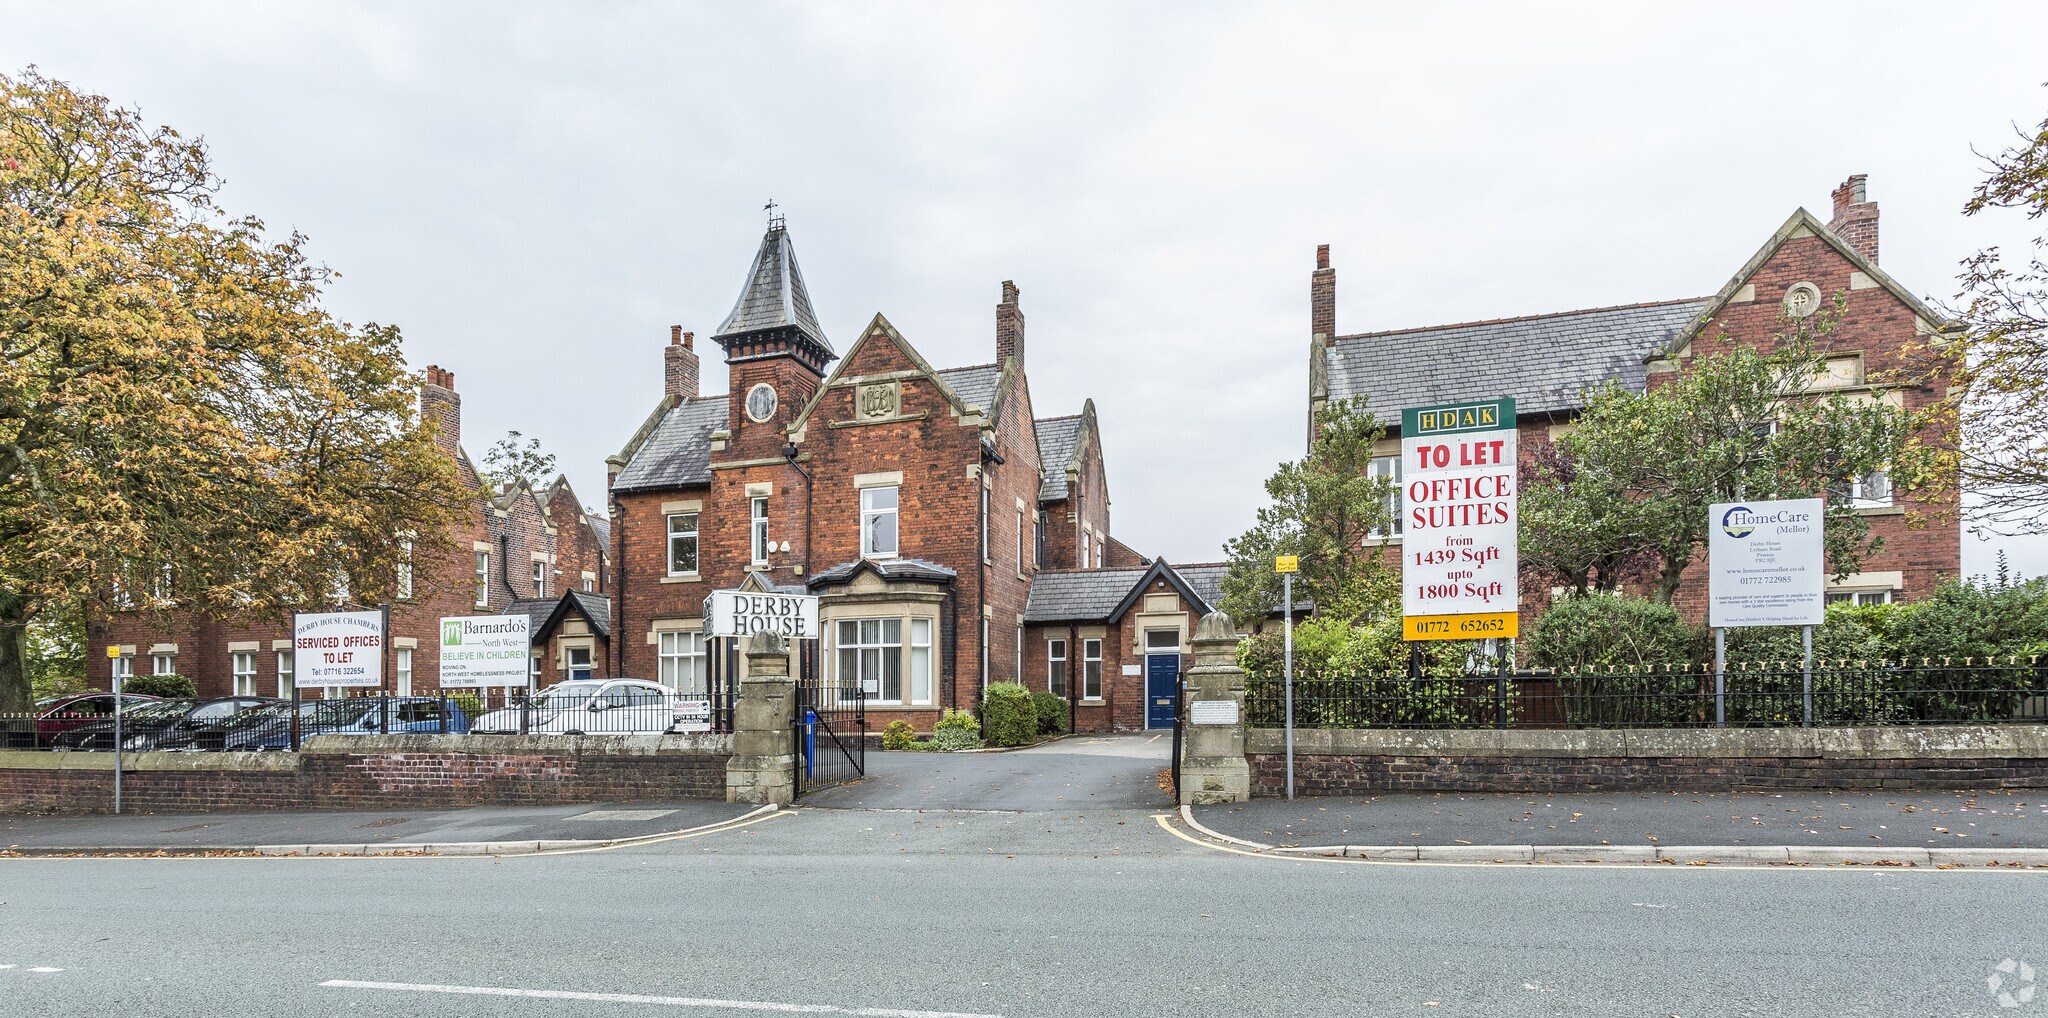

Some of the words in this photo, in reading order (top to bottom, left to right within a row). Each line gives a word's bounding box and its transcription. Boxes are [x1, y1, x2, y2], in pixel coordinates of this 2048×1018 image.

[1422, 408, 1494, 429] HDAK
[1417, 444, 1450, 469] TO
[1460, 440, 1504, 466] LET
[1409, 474, 1511, 503] OFFICE
[1413, 501, 1509, 529] SUITES
[1734, 510, 1809, 525] HomeCare
[1776, 525, 1810, 535] (Mellor)
[1446, 536, 1473, 547] from
[1415, 549, 1455, 566] 1439
[1461, 546, 1500, 569] Sqft
[1447, 570, 1473, 582] upto
[1726, 566, 1806, 574] www.homecaremellor.co.uk
[1740, 577, 1762, 585] 01772
[1765, 576, 1792, 584] 722985
[1418, 583, 1458, 599] 1800
[1464, 581, 1503, 603] Sqft
[733, 595, 805, 617] DERBY
[297, 621, 319, 635] DERBY
[320, 617, 342, 627] HOUSE
[343, 617, 379, 632] CHAMBERS
[464, 619, 526, 635] Barnardo's
[732, 615, 806, 637] HOUSE
[1416, 621, 1449, 633] 01772
[1460, 619, 1504, 632] 652652
[297, 637, 339, 649] SERVICED
[343, 635, 380, 648] OFFICES
[482, 639, 500, 647] North
[502, 638, 518, 647] West
[323, 652, 335, 664] TO
[337, 652, 354, 664] LET
[442, 651, 474, 661] BELIEVE
[476, 651, 485, 660] IN
[486, 651, 526, 660] CHILDREN
[312, 668, 322, 676] Tel:
[343, 667, 365, 675] 322654
[298, 677, 379, 685] www.derbyhouseproperties.co.uk
